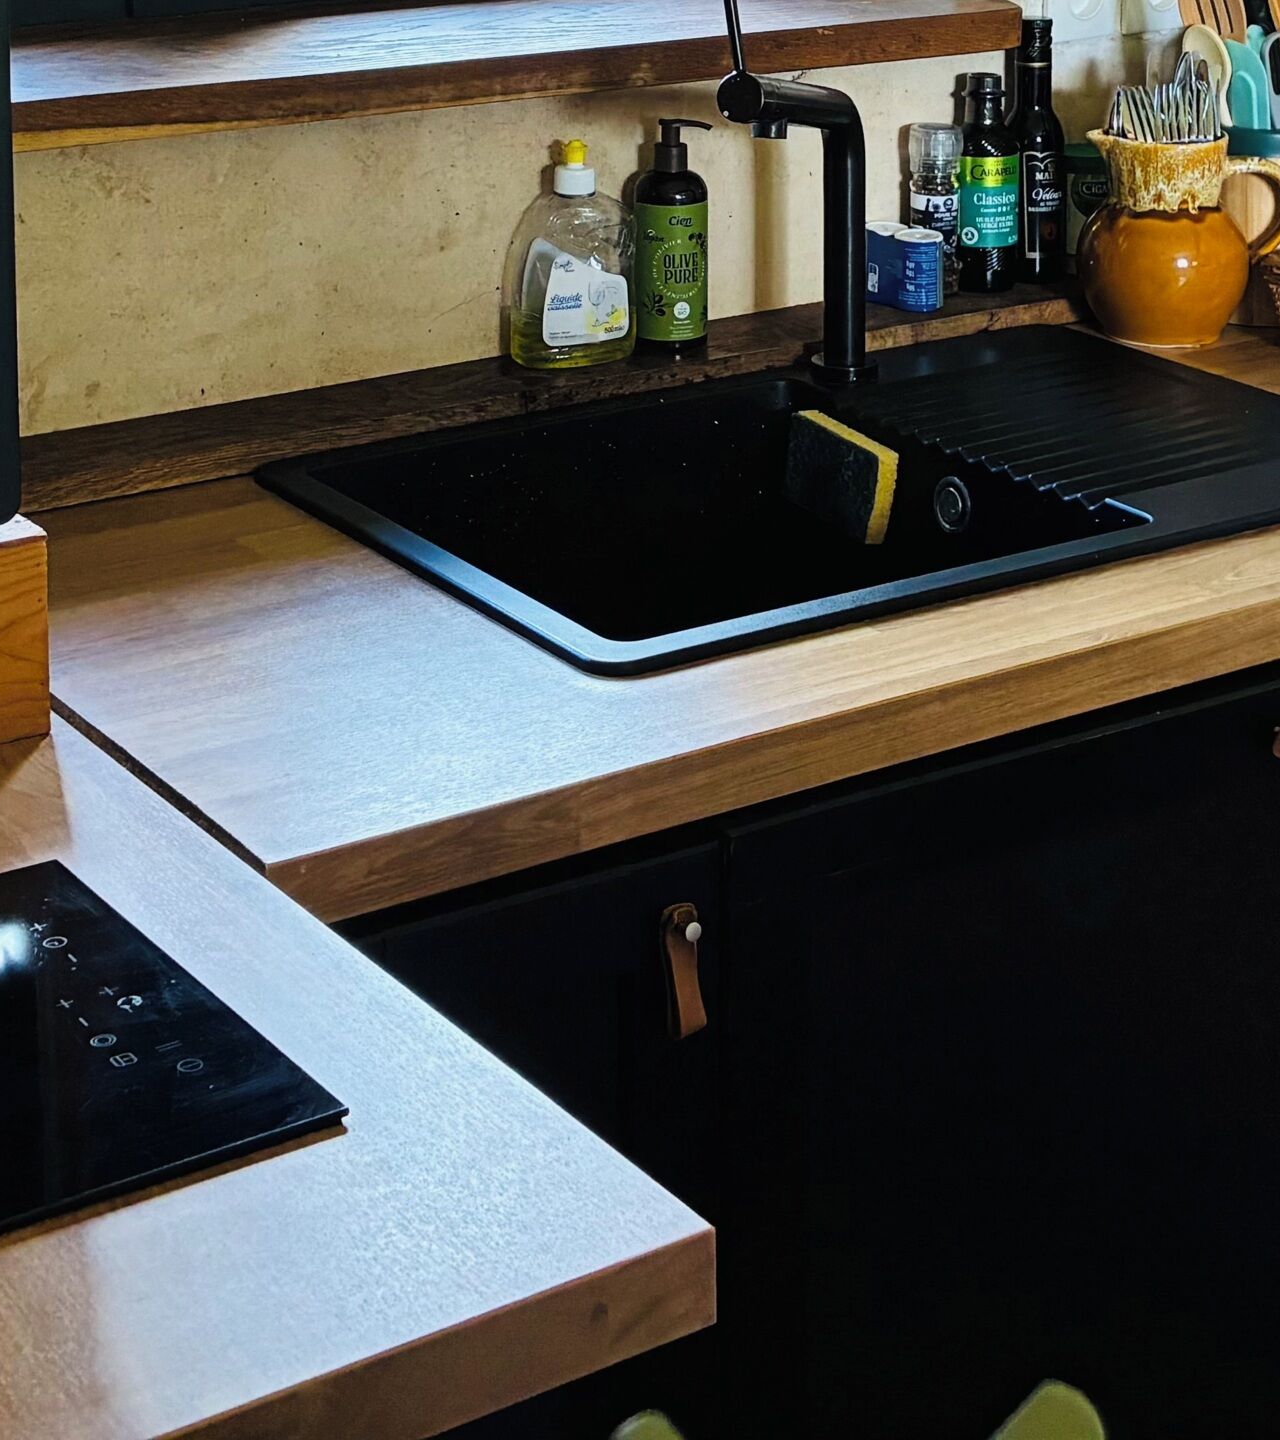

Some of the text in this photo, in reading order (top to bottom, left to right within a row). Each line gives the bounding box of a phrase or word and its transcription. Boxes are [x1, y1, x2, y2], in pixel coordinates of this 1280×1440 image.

[973, 192, 1016, 205] Classico
[668, 216, 693, 227] Cien
[663, 252, 699, 269] OLIVE
[664, 268, 699, 284] PURE
